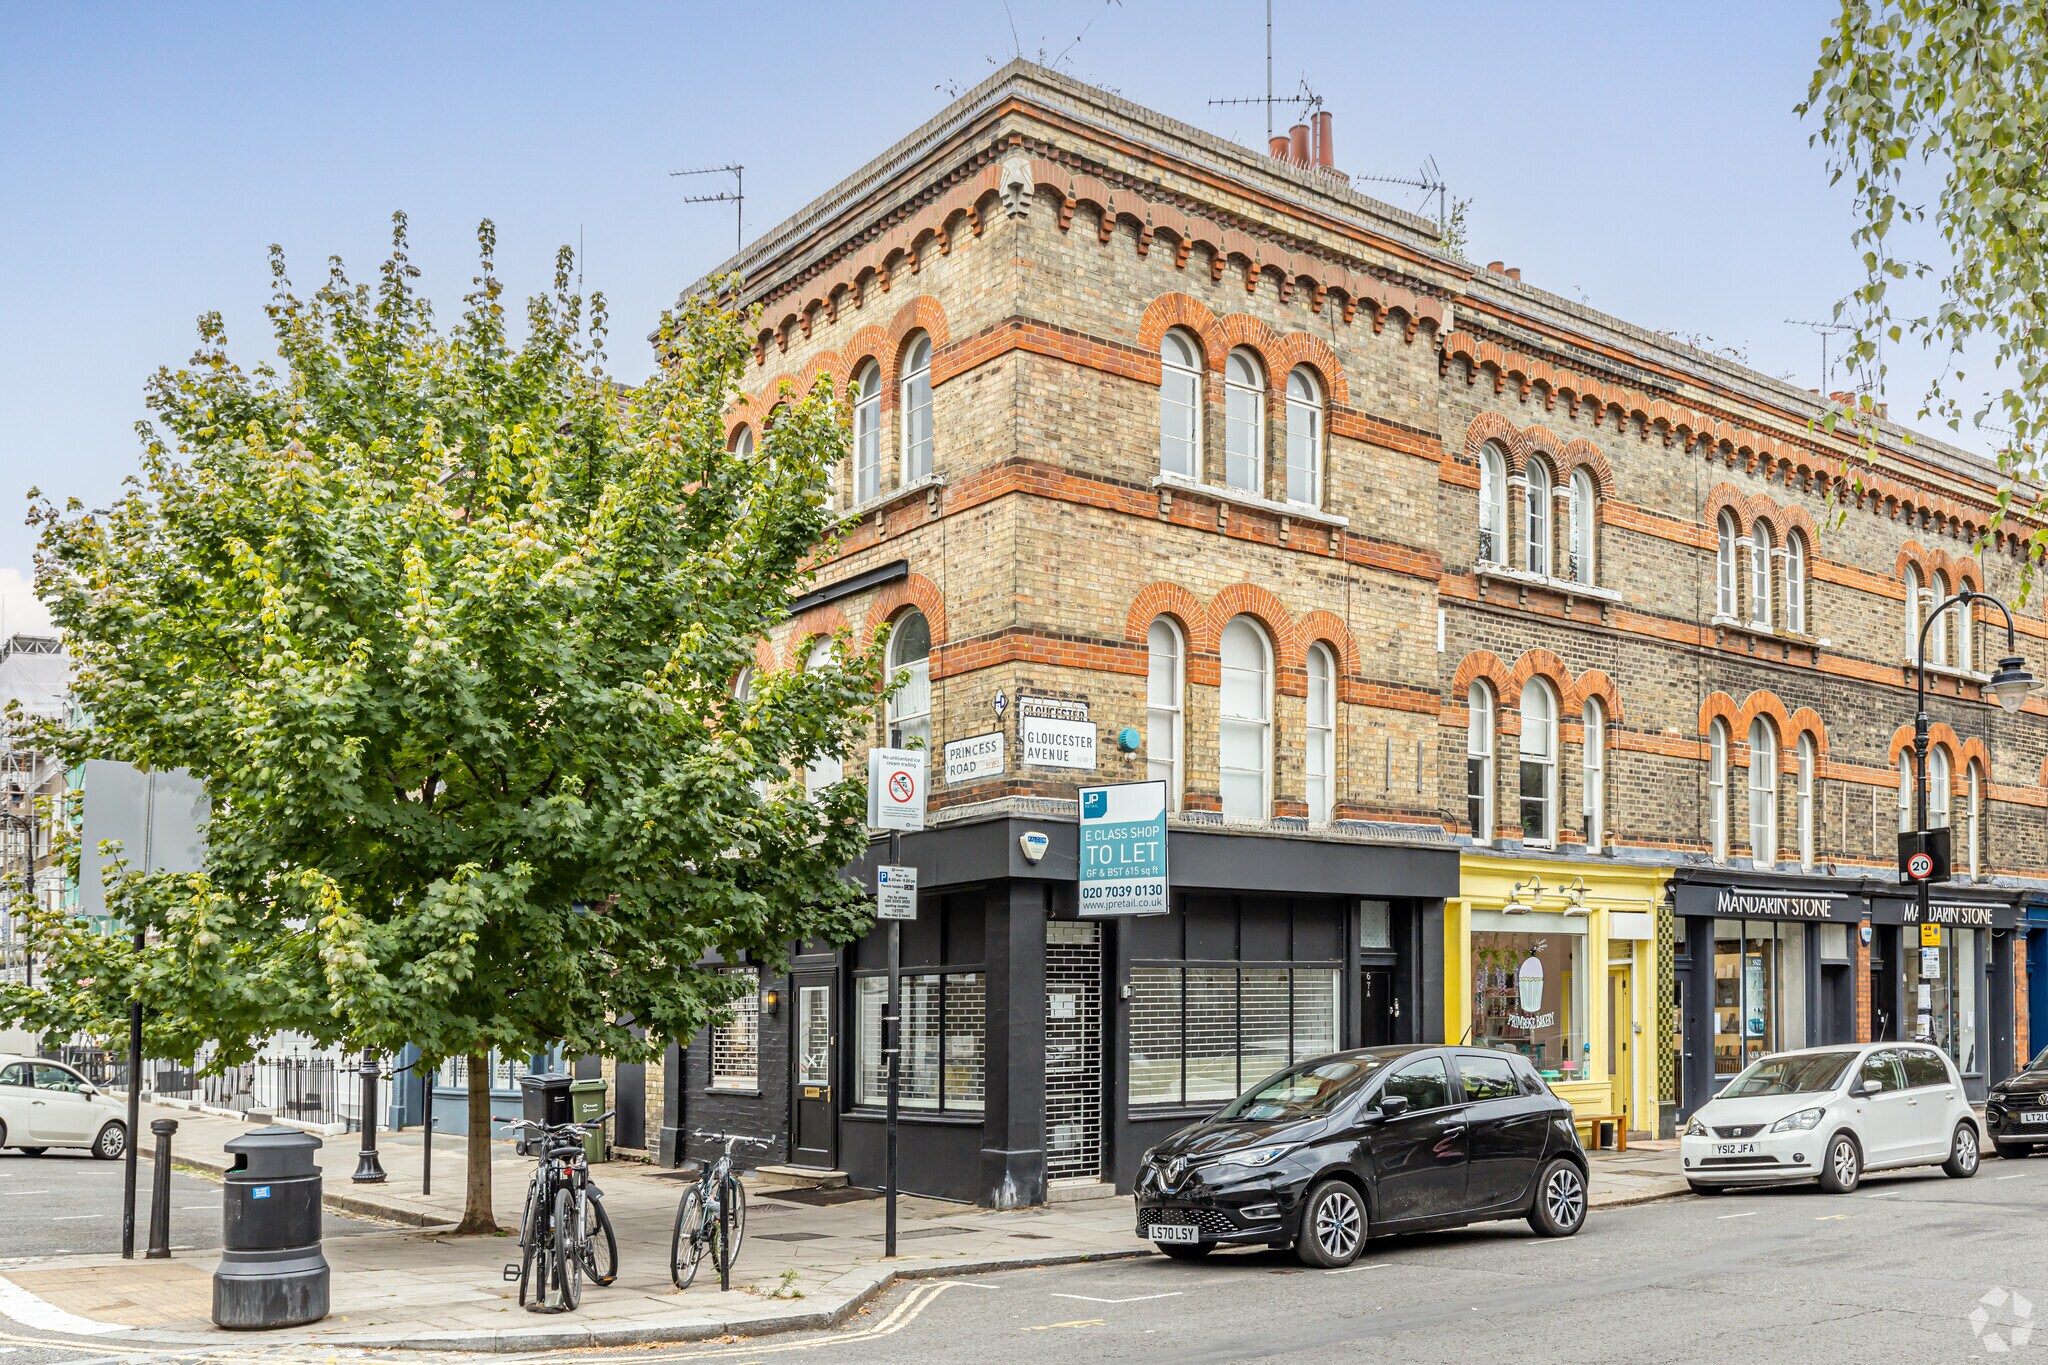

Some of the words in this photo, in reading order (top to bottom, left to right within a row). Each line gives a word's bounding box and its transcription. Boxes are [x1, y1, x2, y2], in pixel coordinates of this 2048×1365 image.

[1027, 732, 1093, 748] GLOUCESTER
[950, 741, 997, 760] PRINCESS
[1027, 747, 1069, 762] AVENUE
[950, 762, 977, 776] ROAD
[1084, 793, 1099, 805] JP
[1085, 830, 1092, 842] E
[1094, 828, 1128, 841] CLASS
[1130, 825, 1160, 839] SHOP
[1086, 845, 1112, 865] TO
[1120, 841, 1159, 864] LET
[1086, 868, 1097, 878] GF
[1099, 868, 1105, 877] &
[1107, 867, 1123, 877] BST
[1125, 866, 1139, 876] 615
[1140, 867, 1151, 877] sq
[1152, 865, 1158, 875] ft
[1912, 861, 1928, 871] 20
[881, 872, 887, 881] P
[1082, 887, 1102, 899] 020
[1105, 885, 1132, 898] 7039
[1134, 884, 1162, 896] 0130
[1082, 897, 1163, 911] www.jpretail.co.uk
[1717, 890, 1788, 915] MANDARIN
[1791, 898, 1831, 917] STONE
[1903, 902, 1959, 923] MADARIN
[1961, 907, 1993, 925] STONE
[1507, 1014, 1536, 1029] PRIMROSE
[1536, 1011, 1555, 1028] BAKERY
[2026, 1113, 2044, 1122] LT21
[1717, 1144, 1736, 1154] YS12
[1737, 1143, 1754, 1154] JFA
[1152, 1226, 1174, 1239] LS70
[1176, 1227, 1194, 1240] LSY
